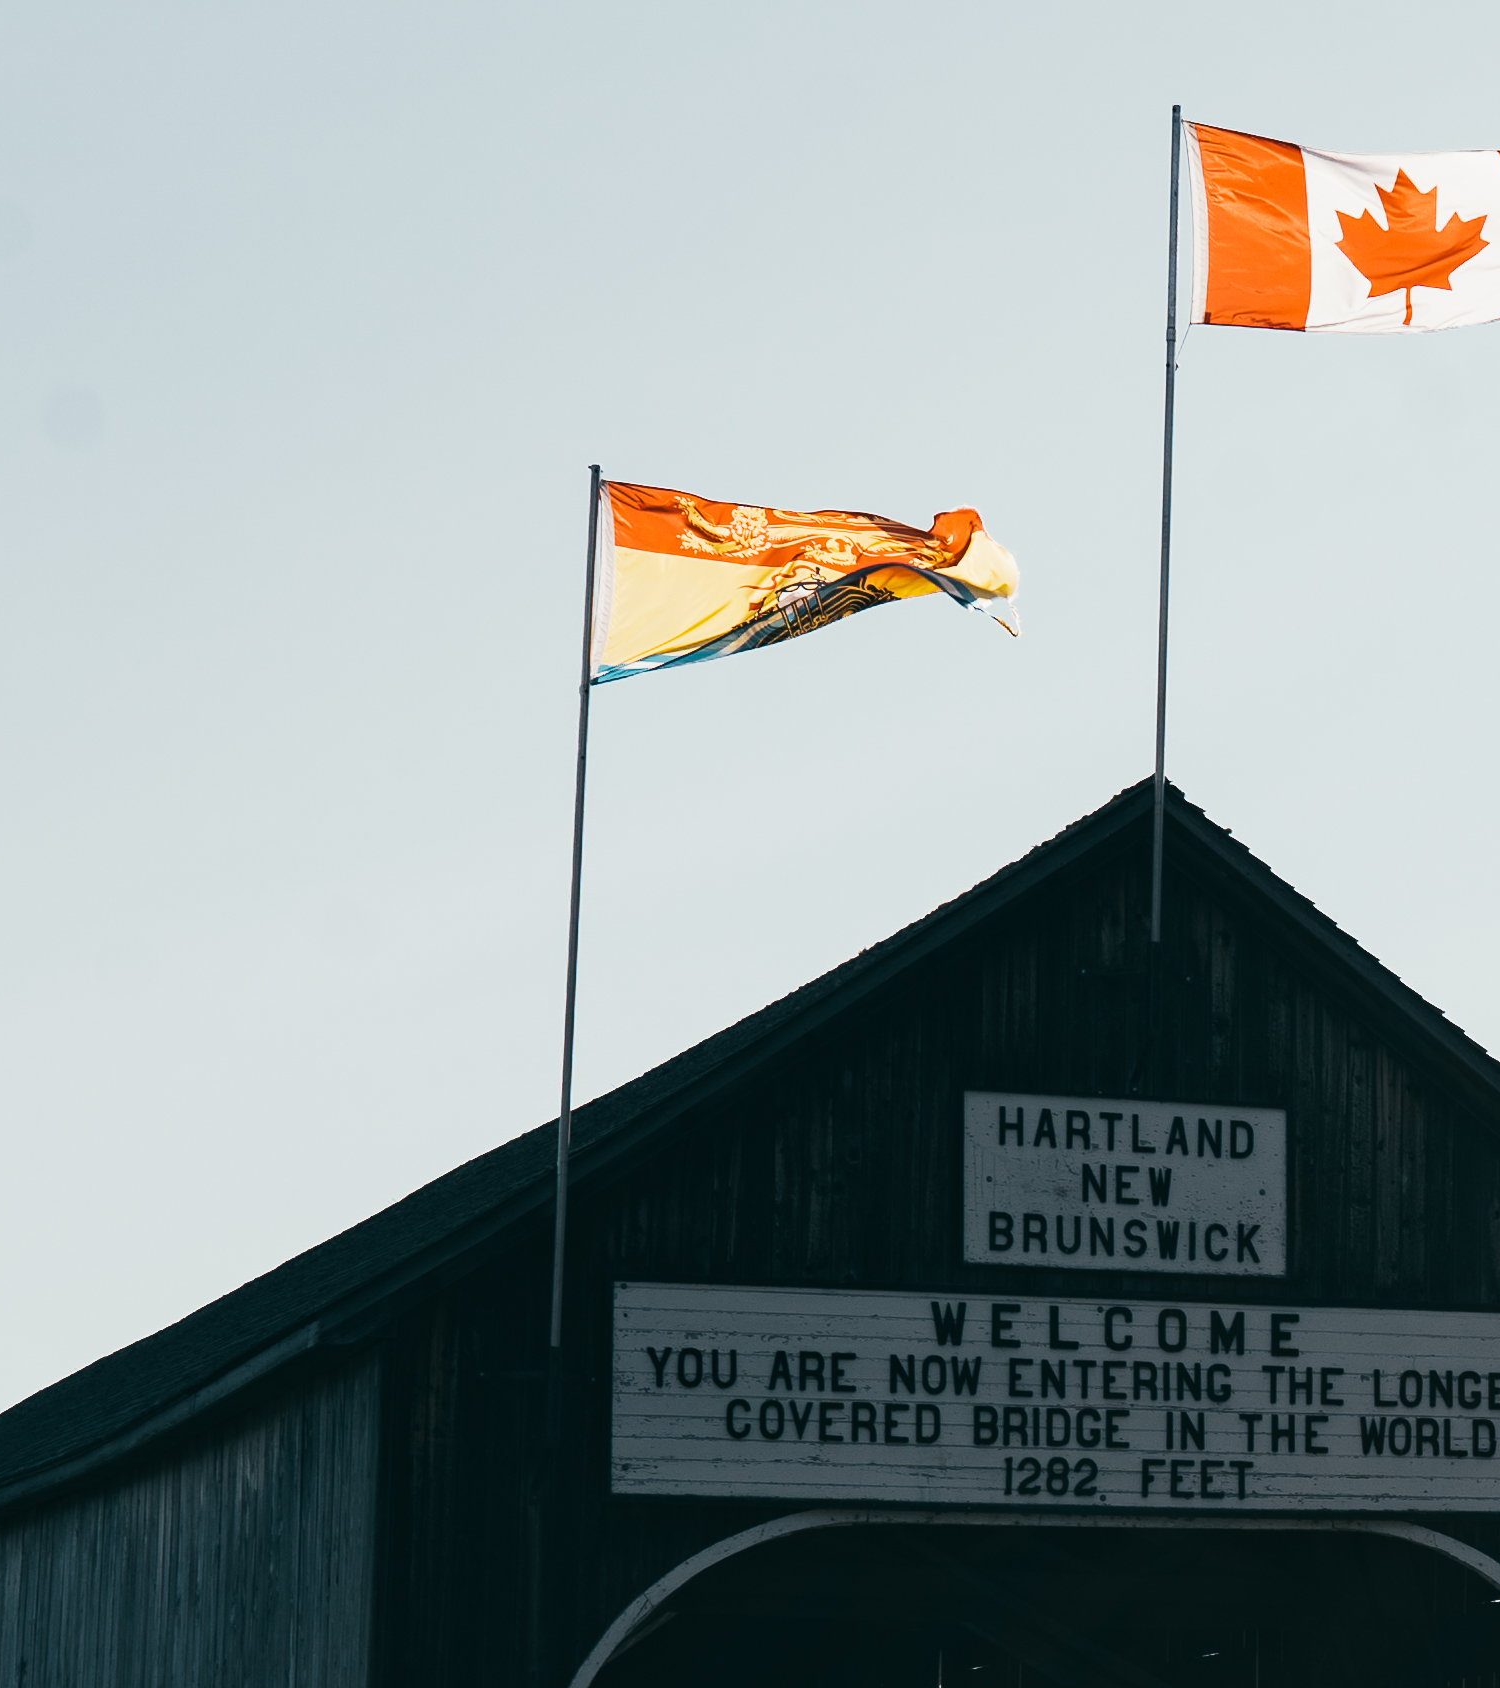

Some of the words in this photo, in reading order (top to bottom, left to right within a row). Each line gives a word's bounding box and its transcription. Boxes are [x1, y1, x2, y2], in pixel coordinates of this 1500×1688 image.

[999, 1106, 1254, 1159] HARTLAND
[1082, 1164, 1172, 1207] NEW
[989, 1211, 1260, 1263] BRUNSWICK
[930, 1301, 1299, 1357] WELCOME
[645, 1347, 737, 1389] YOU
[767, 1351, 857, 1393] ARE
[889, 1354, 982, 1396] NOW
[1008, 1358, 1232, 1404] ENTERING
[1262, 1365, 1344, 1406] THE
[725, 1399, 941, 1444] COVERED
[972, 1405, 1130, 1449] BRIDGE
[1166, 1410, 1205, 1450] IN
[1239, 1413, 1328, 1454] THE
[1360, 1416, 1496, 1459] WORLD
[1003, 1457, 1098, 1497] 1282
[1141, 1459, 1253, 1500] FEET
